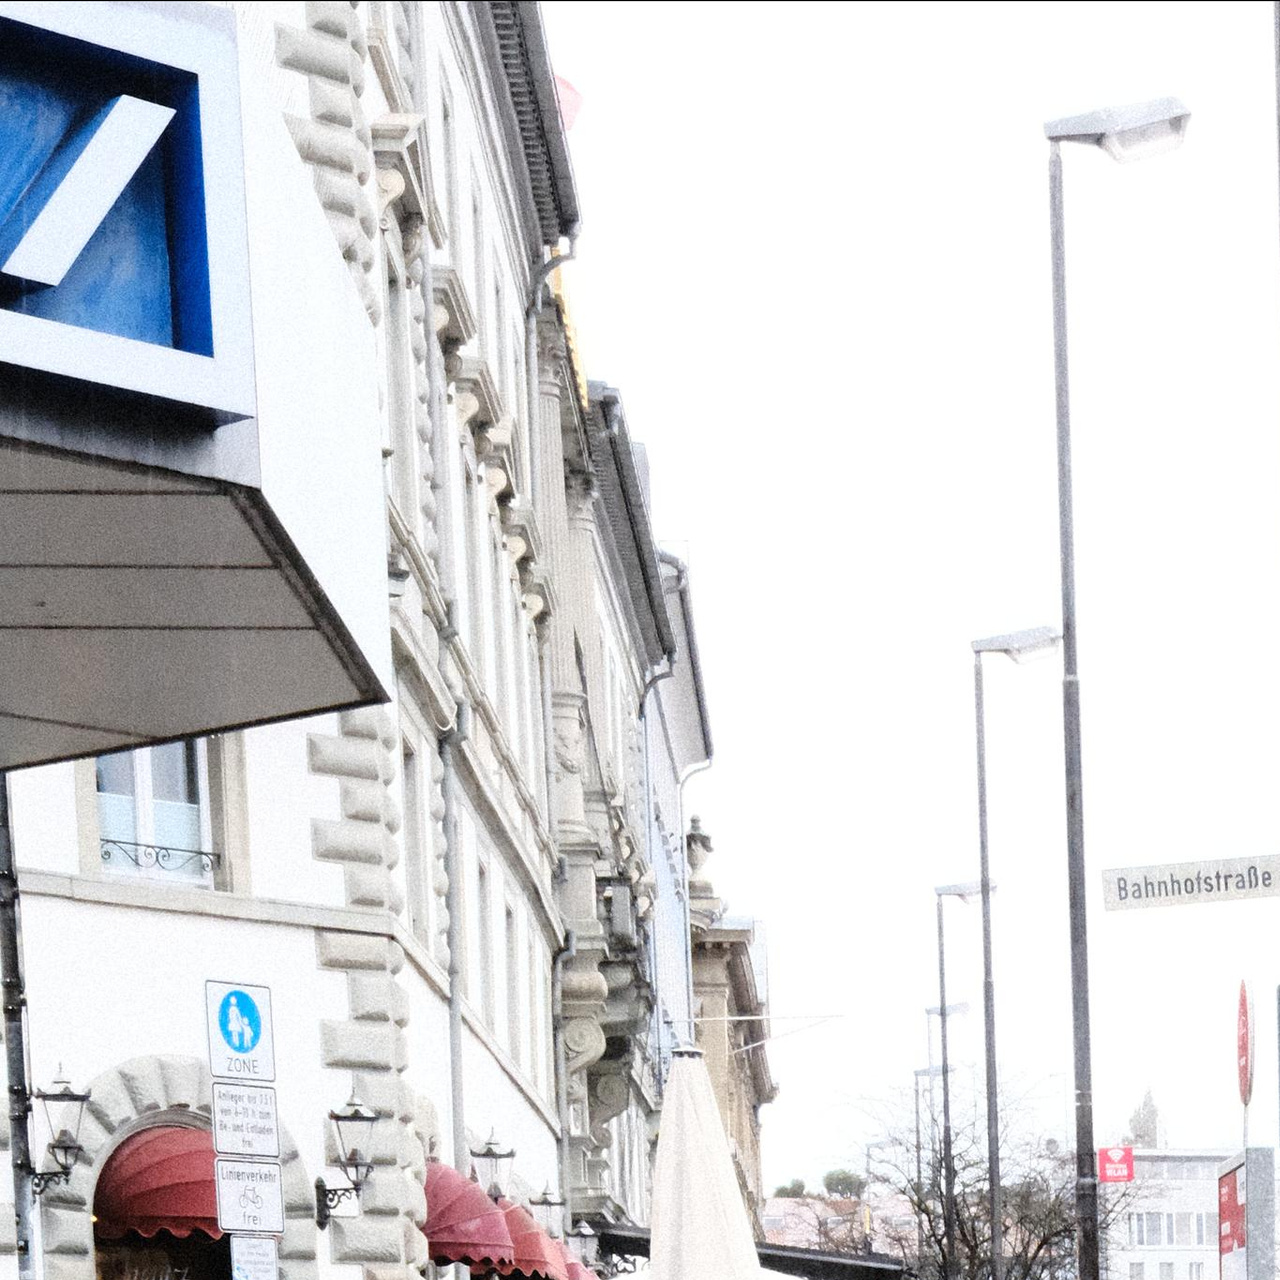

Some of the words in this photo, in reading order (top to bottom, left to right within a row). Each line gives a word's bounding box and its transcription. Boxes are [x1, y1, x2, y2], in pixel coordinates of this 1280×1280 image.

[1117, 866, 1272, 901] Bahnhofstraße
[226, 1057, 261, 1075] ZONE
[221, 1165, 277, 1183] Linienverkehr
[242, 1211, 262, 1226] frei
